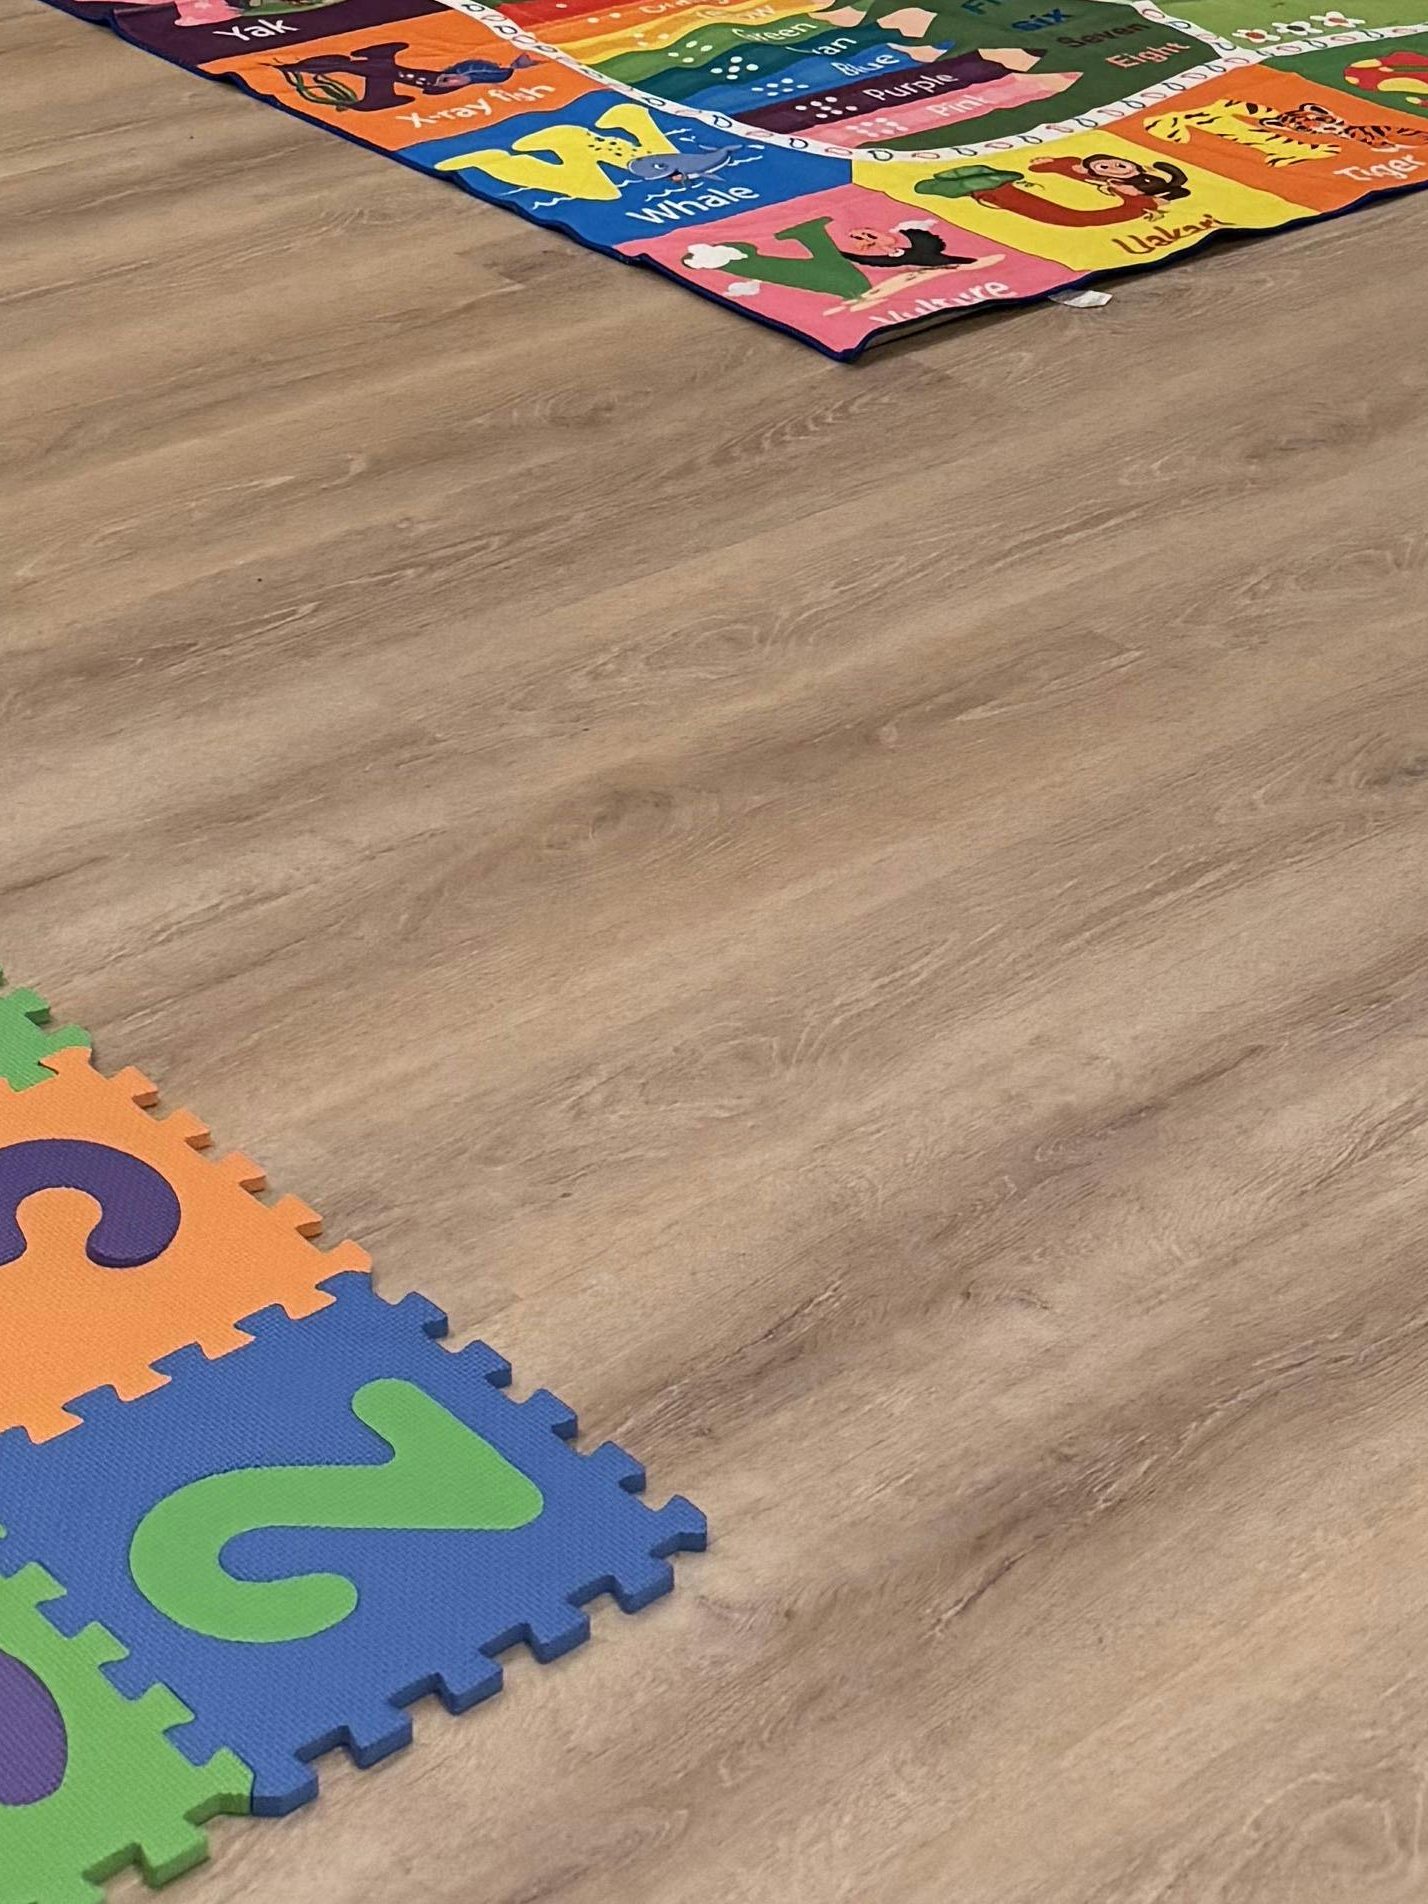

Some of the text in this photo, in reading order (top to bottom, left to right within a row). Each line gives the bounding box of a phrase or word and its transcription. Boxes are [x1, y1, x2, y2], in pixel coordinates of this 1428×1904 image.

[212, 18, 300, 45] Yak
[1056, 20, 1152, 49] Seven
[830, 51, 902, 77] Blue
[1105, 40, 1192, 70] Eight
[862, 71, 960, 105] Purple
[394, 83, 556, 130] X-ray fish
[925, 94, 984, 118] Pink
[435, 103, 680, 202] W
[1334, 149, 1428, 183] Tiger
[625, 184, 760, 226] Whale
[717, 215, 874, 302] V
[129, 1378, 546, 1645] 2
